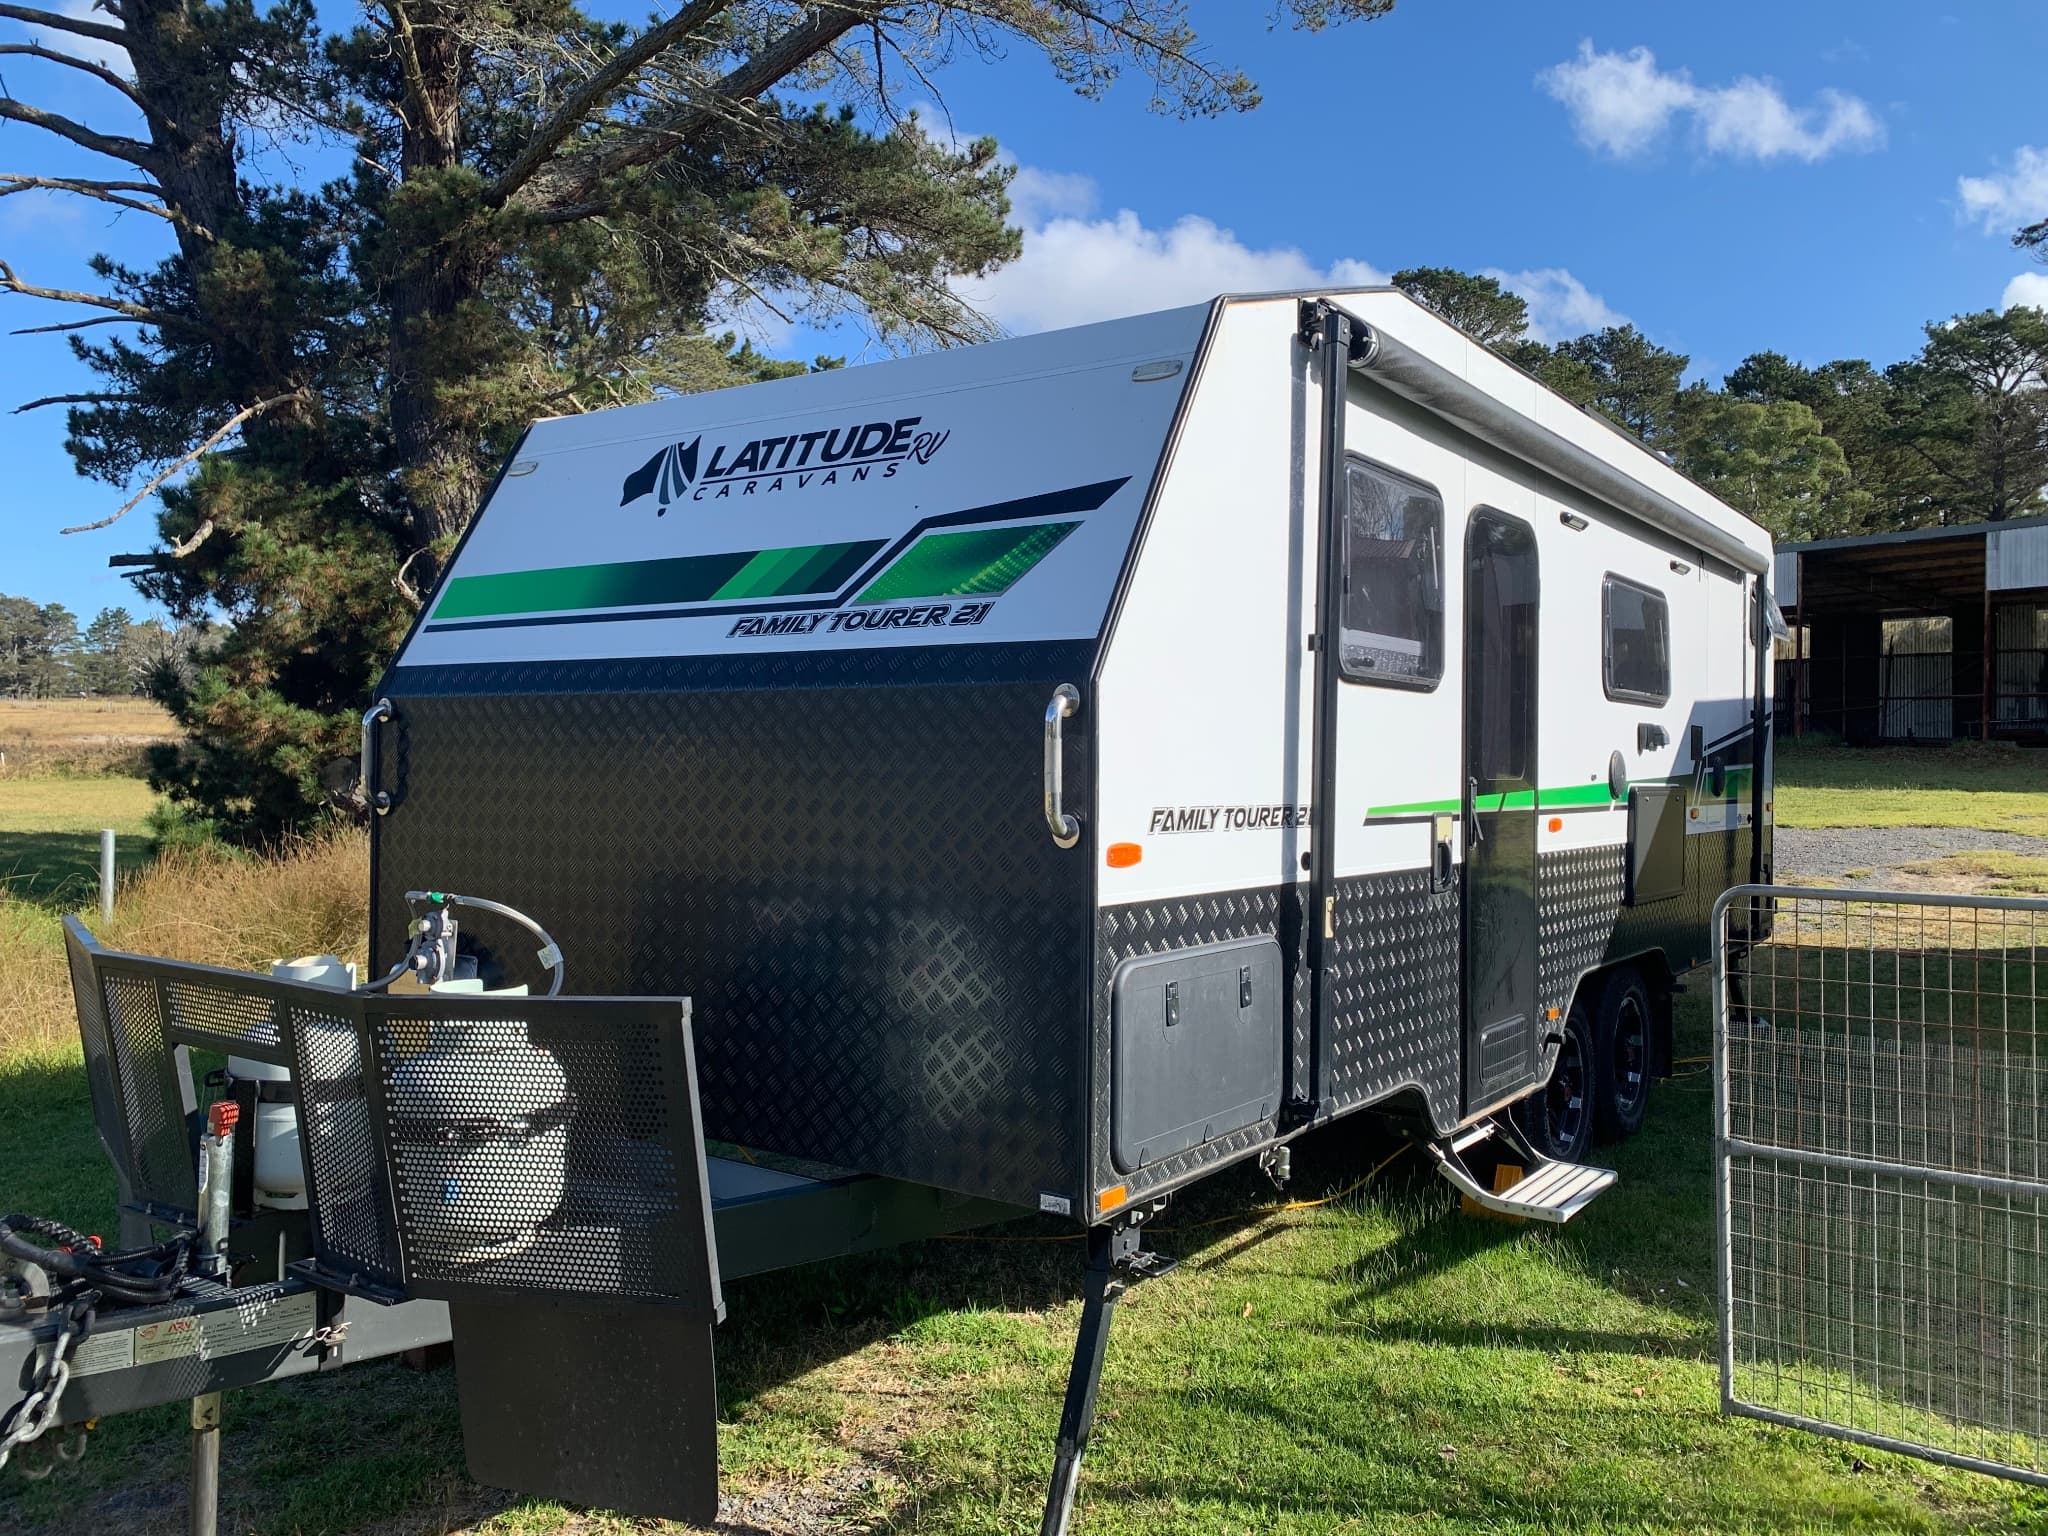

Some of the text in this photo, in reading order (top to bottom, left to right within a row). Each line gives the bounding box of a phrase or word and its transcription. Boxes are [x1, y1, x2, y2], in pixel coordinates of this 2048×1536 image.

[702, 416, 951, 480] LATITUDE RV
[692, 462, 900, 502] CARAVANS
[725, 600, 997, 639] FAMILY TOURER 21
[1147, 806, 1222, 835] FAMILY
[1222, 804, 1295, 831] TOURER
